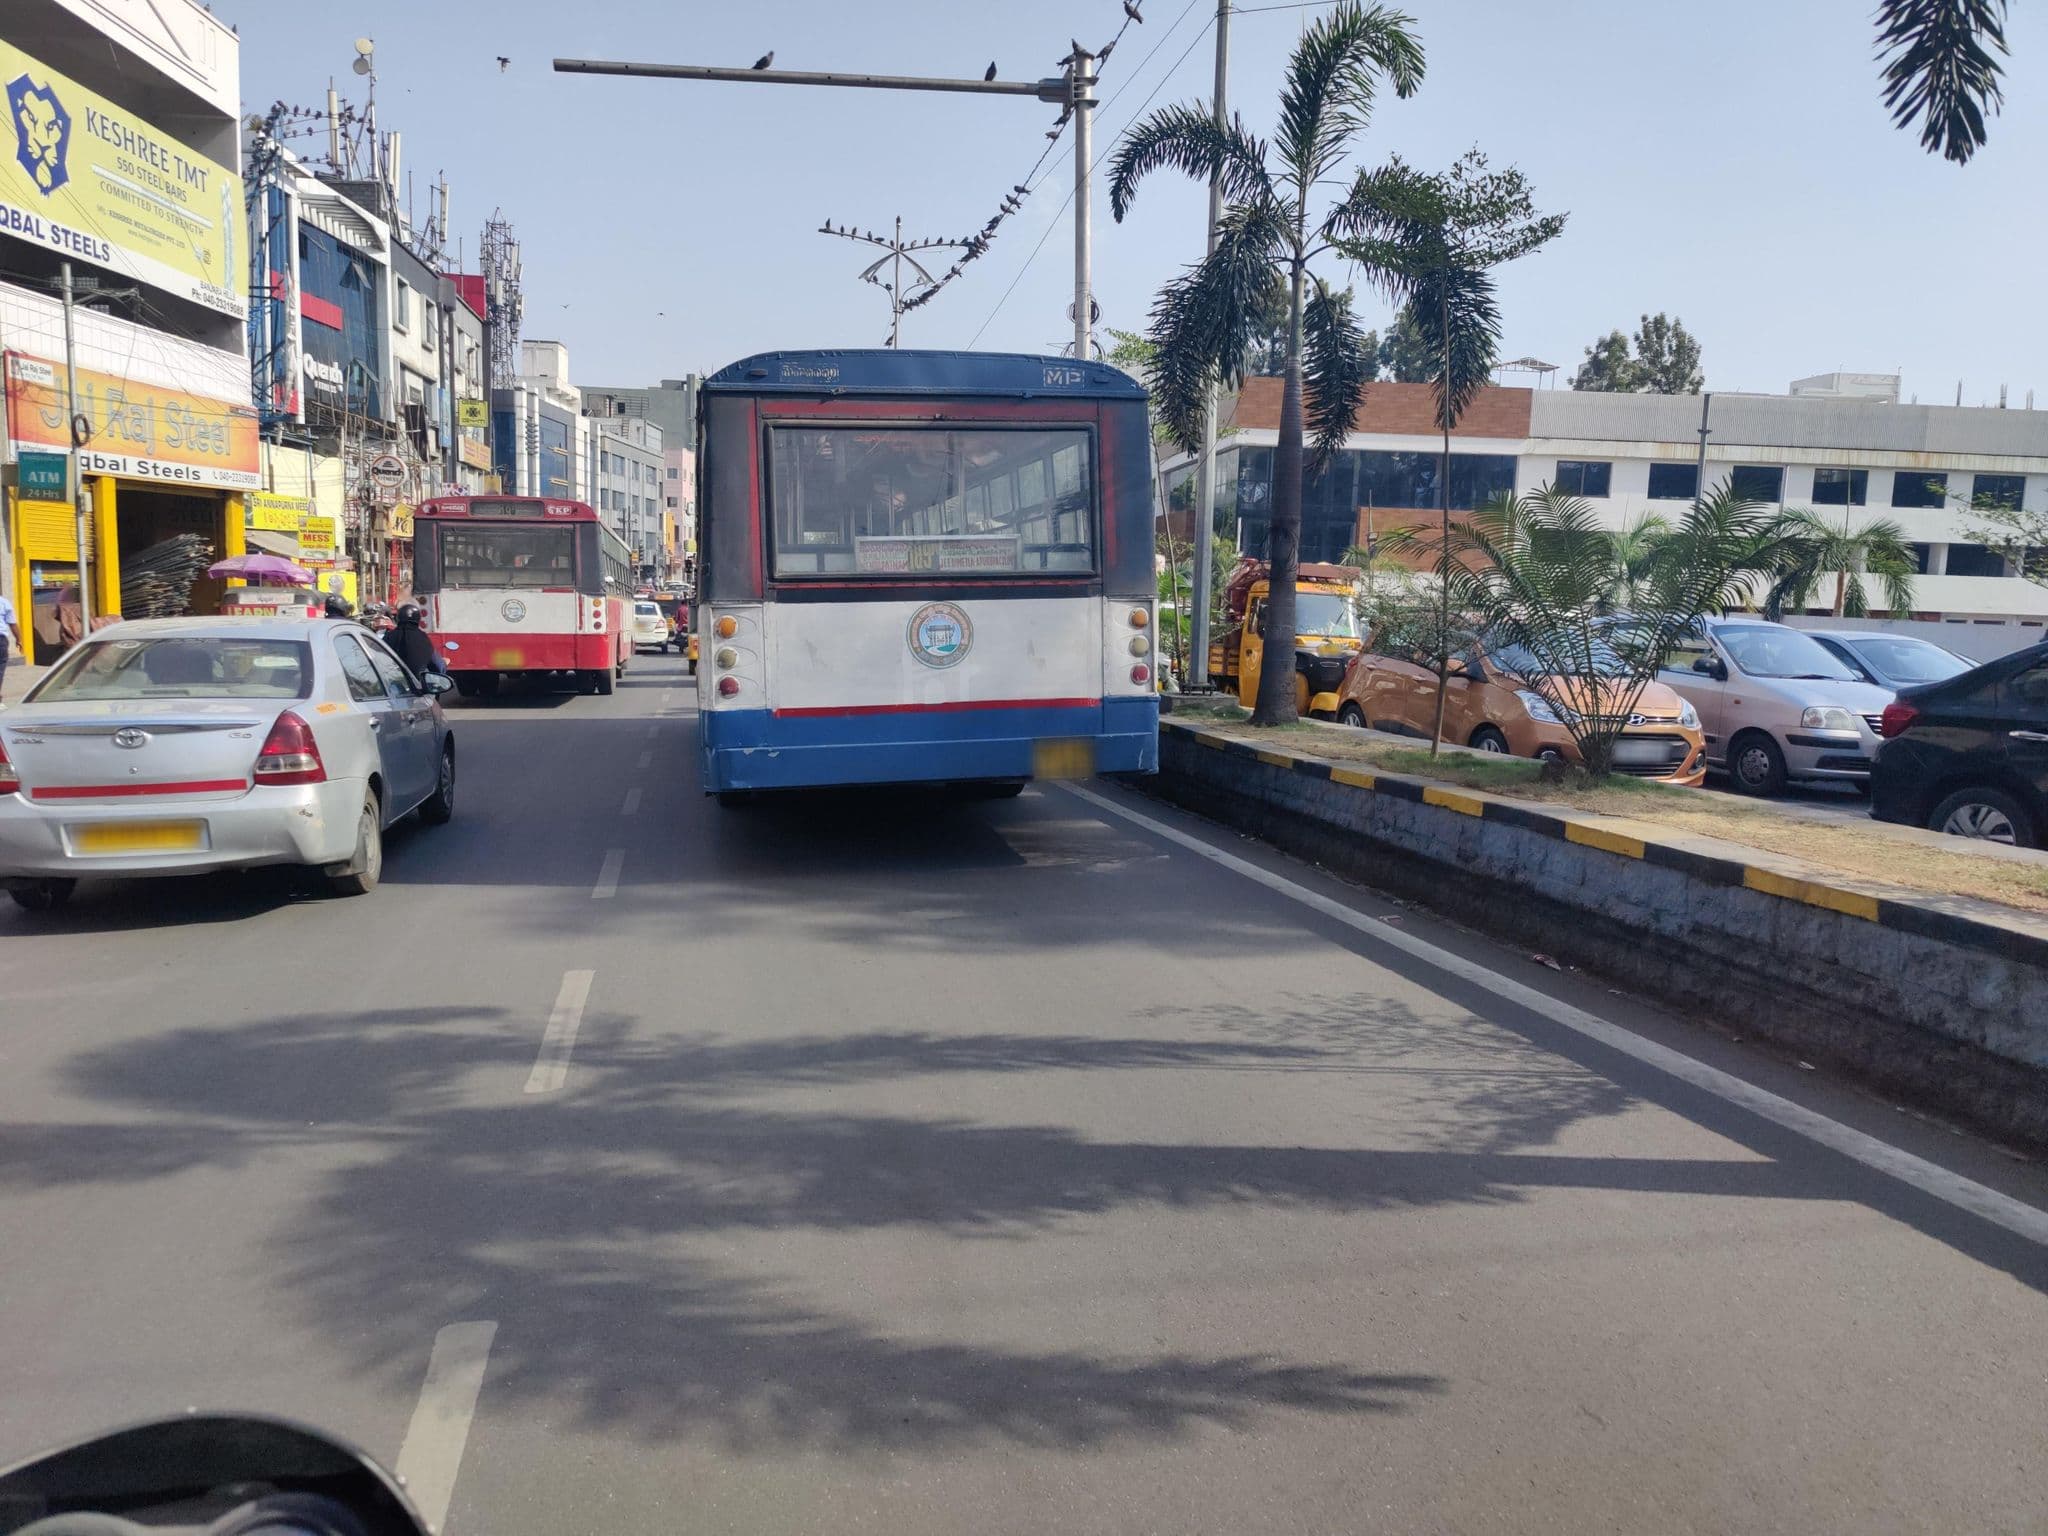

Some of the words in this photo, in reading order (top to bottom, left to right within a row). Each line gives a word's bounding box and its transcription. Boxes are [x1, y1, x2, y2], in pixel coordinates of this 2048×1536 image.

[85, 106, 170, 174] KESHREE
[173, 155, 208, 193] TMT
[137, 166, 164, 191] STEEL
[165, 181, 187, 203] BARS
[99, 180, 152, 212] COMMITTED
[153, 205, 164, 218] TO
[166, 211, 204, 237] STRENGTH
[50, 224, 110, 262] STEELS
[107, 386, 155, 455] Raj
[165, 401, 231, 455] Steel
[28, 471, 60, 483] ATM
[80, 454, 127, 472] qbal
[137, 461, 201, 481] Steels
[27, 488, 40, 498] 24
[303, 533, 330, 542] MESS
